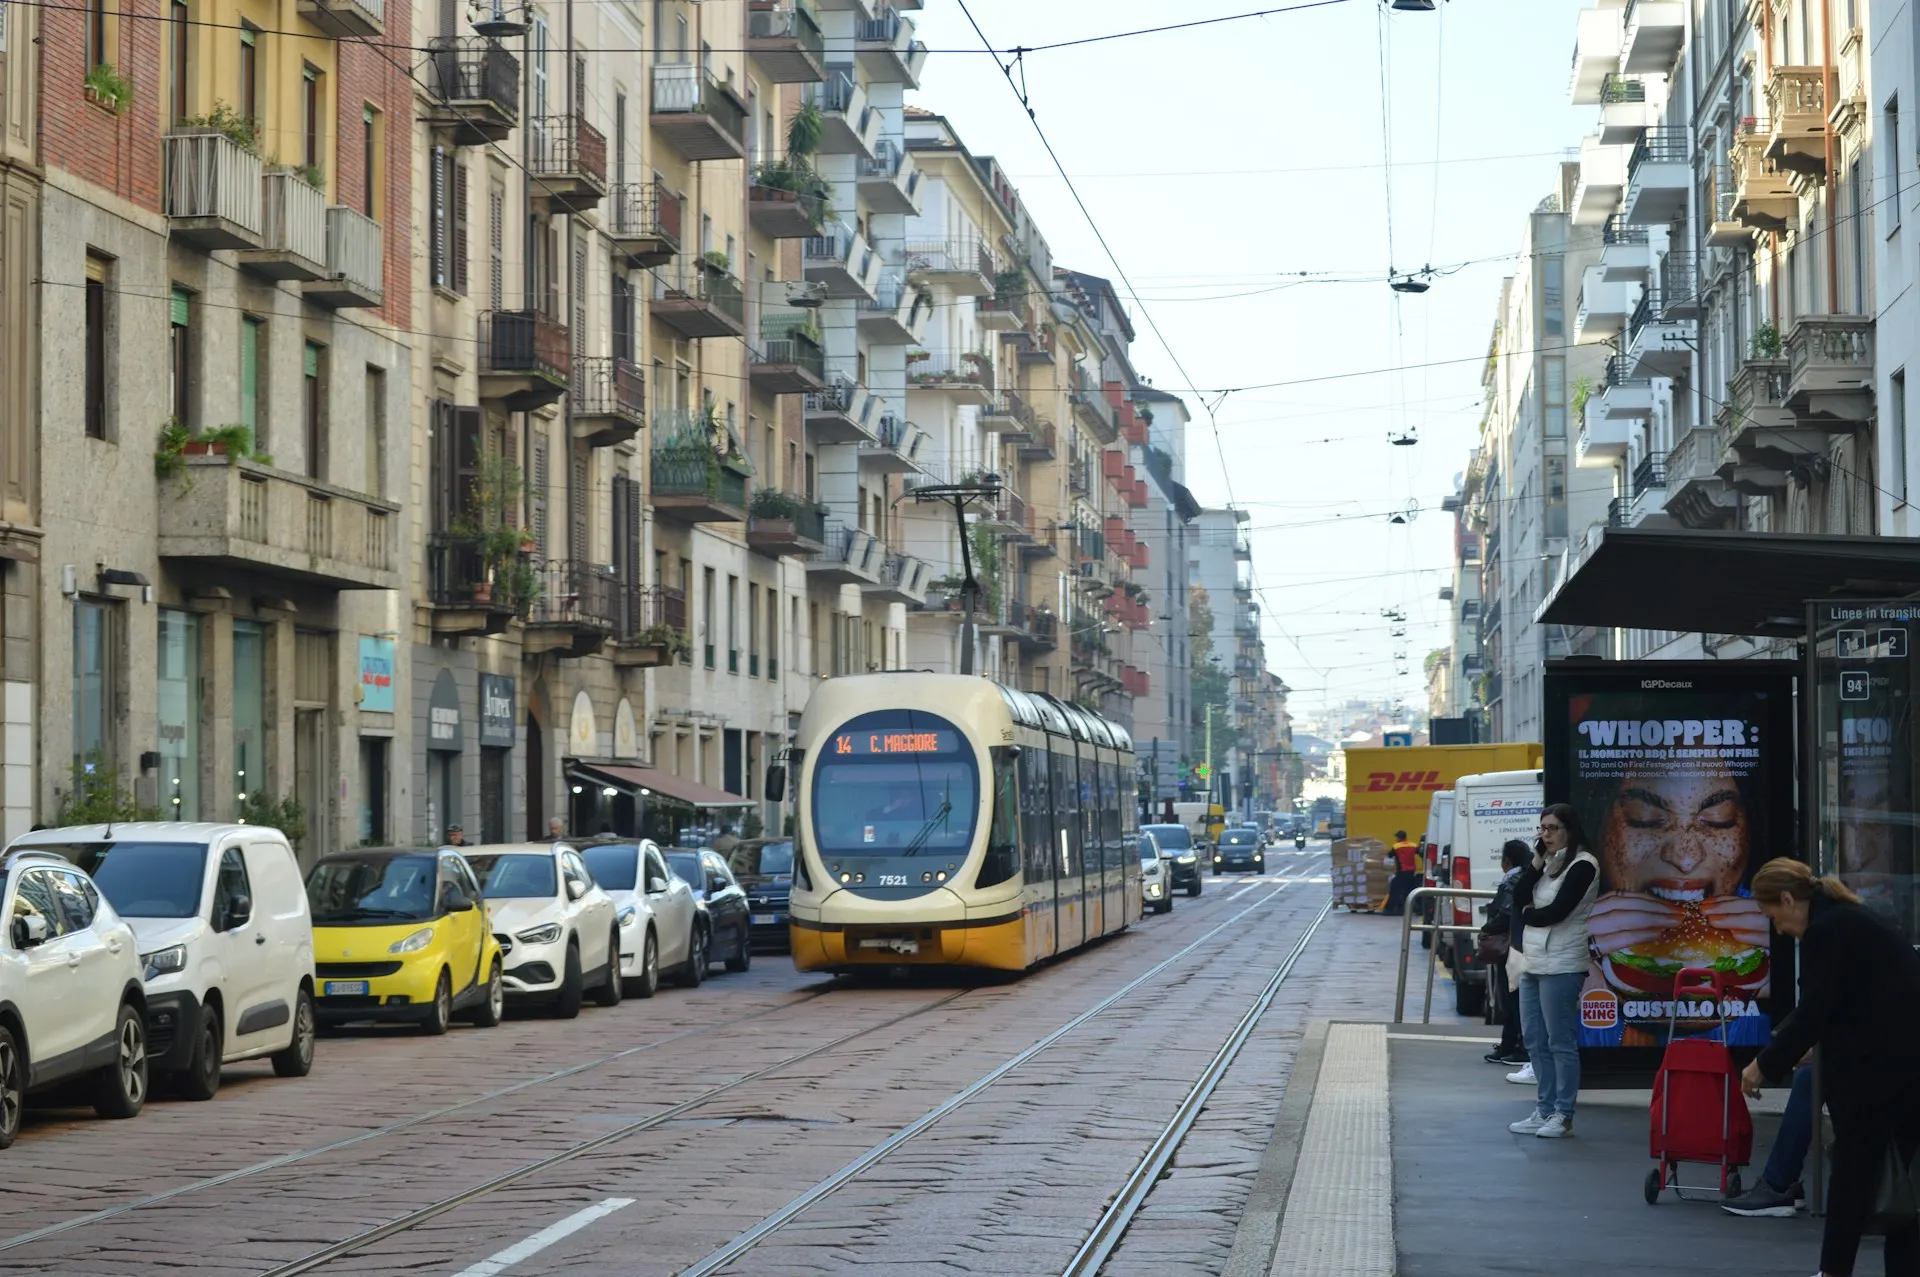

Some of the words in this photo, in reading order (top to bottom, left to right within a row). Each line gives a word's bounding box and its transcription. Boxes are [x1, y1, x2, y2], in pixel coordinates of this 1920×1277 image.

[1831, 607, 1862, 619] Linee
[1866, 606, 1877, 619] in
[1844, 637, 1859, 651] 14
[1889, 636, 1897, 649] 2
[1641, 680, 1692, 689] IGPDecaux
[1847, 680, 1863, 692] 94
[836, 736, 852, 754] 14
[870, 735, 882, 752] C.
[884, 733, 938, 752] MAGGIORE
[1578, 749, 1589, 759] IL
[1590, 749, 1644, 759] MOMENTO
[1645, 749, 1666, 760] BBQ
[1676, 748, 1718, 758] SEMPRE
[1719, 748, 1734, 758] ON
[1735, 747, 1759, 758] FIRE
[1580, 761, 1589, 769] Da
[1724, 760, 1759, 769] Whopper:
[1585, 770, 1610, 779] panino
[1638, 770, 1667, 778] conosci,
[1718, 769, 1749, 779] gustoso.
[1367, 771, 1445, 792] DHL
[879, 875, 908, 886] 7521
[1582, 1010, 1616, 1020] KING
[1623, 1000, 1714, 1018] GUSTALO
[1717, 1000, 1760, 1017] ORA
